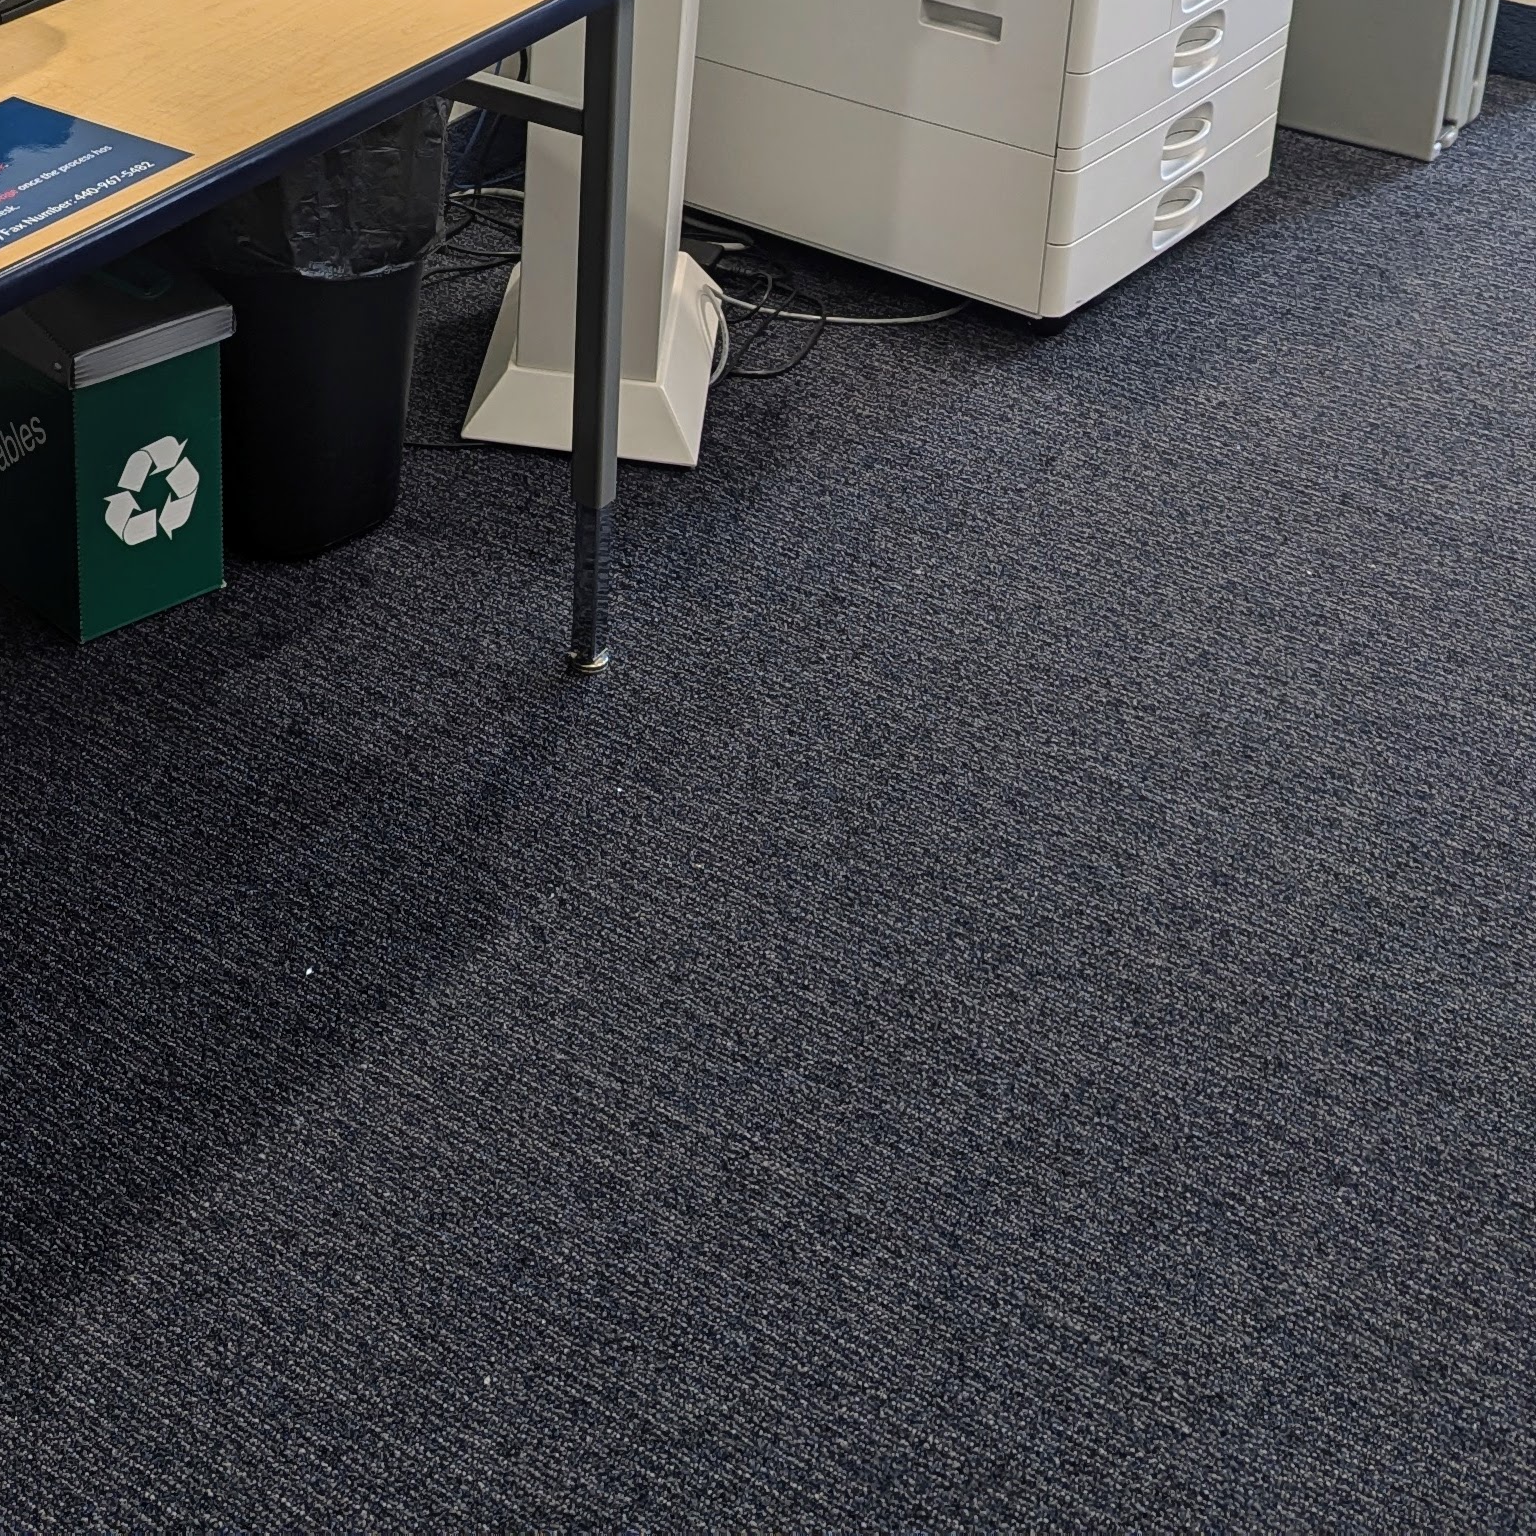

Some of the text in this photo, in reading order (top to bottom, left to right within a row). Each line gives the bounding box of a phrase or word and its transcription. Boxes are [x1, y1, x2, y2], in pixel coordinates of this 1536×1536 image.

[17, 177, 43, 191] once
[40, 168, 60, 180] the
[58, 152, 95, 173] process
[91, 145, 113, 156] has
[2, 223, 28, 236] Fax
[22, 199, 77, 225] Number:
[74, 161, 156, 202] 440-967-5482
